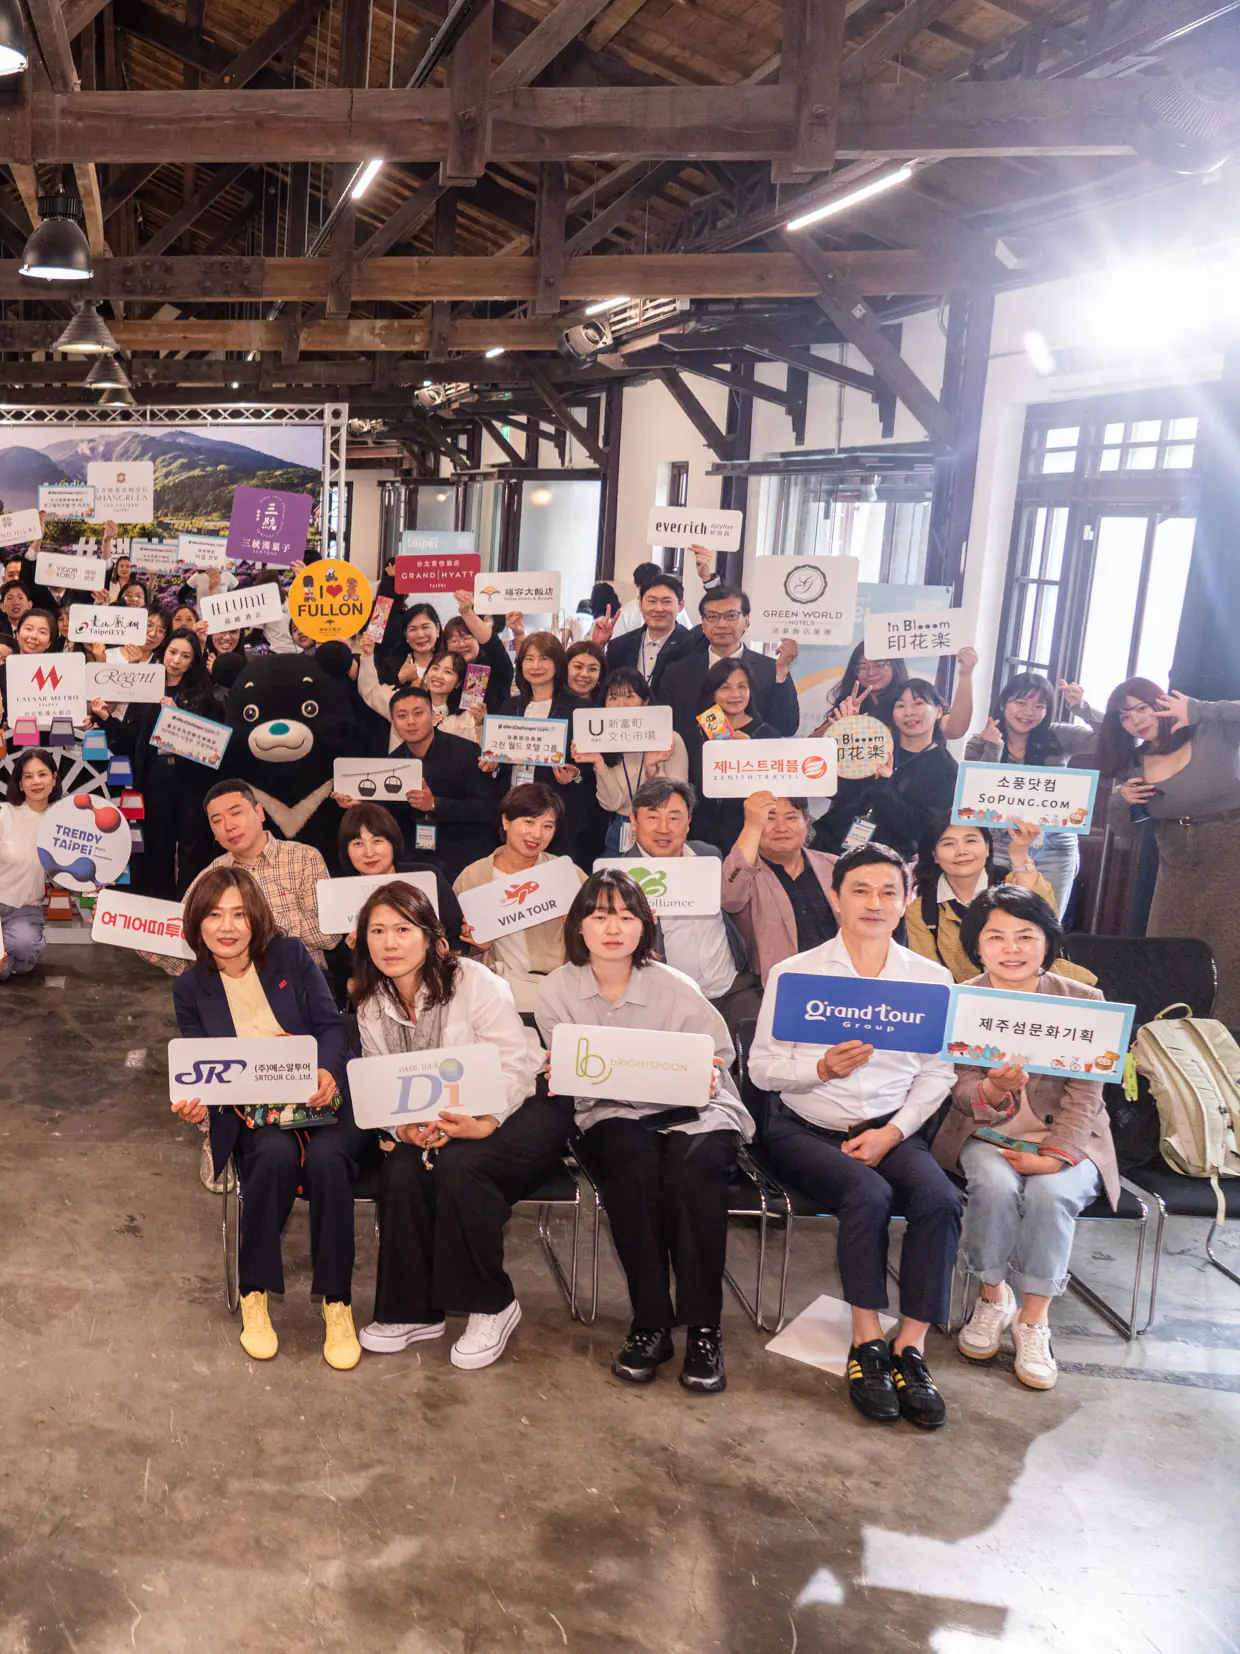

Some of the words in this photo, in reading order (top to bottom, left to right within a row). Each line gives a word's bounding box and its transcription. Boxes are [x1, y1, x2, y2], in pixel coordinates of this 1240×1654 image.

[14, 527, 36, 536] HILAI
[656, 521, 707, 535] everrich
[242, 538, 291, 553] 三統漢菓子
[56, 572, 76, 580] KOBO
[401, 572, 436, 580] GRAND
[441, 571, 474, 579] HYATT
[319, 585, 323, 599] I
[504, 587, 554, 596] 福容大飯店
[298, 603, 363, 617] FULLON
[763, 610, 799, 618] GREEN
[802, 611, 843, 620] WORLD
[89, 628, 127, 637] TaipeiEYE
[94, 668, 156, 689] Regent
[588, 719, 604, 736] U
[608, 718, 643, 729] 新富町
[608, 730, 656, 742] 文化市場
[490, 740, 506, 749] 그린
[508, 741, 522, 751] 월드
[526, 742, 540, 752] 호텔
[544, 743, 558, 753] 그룹
[713, 759, 799, 774] 제니스트래블
[997, 776, 1056, 792] 소풍닷컴
[56, 824, 103, 845] TRENDY
[497, 910, 526, 928] VIVA
[527, 898, 558, 919] TOUR
[842, 1021, 895, 1033] Group
[978, 1017, 1095, 1043] 제주섬문화기획
[174, 1059, 247, 1085] SR
[254, 1063, 311, 1074] (주)에스알투어
[421, 1062, 439, 1071] TOUR
